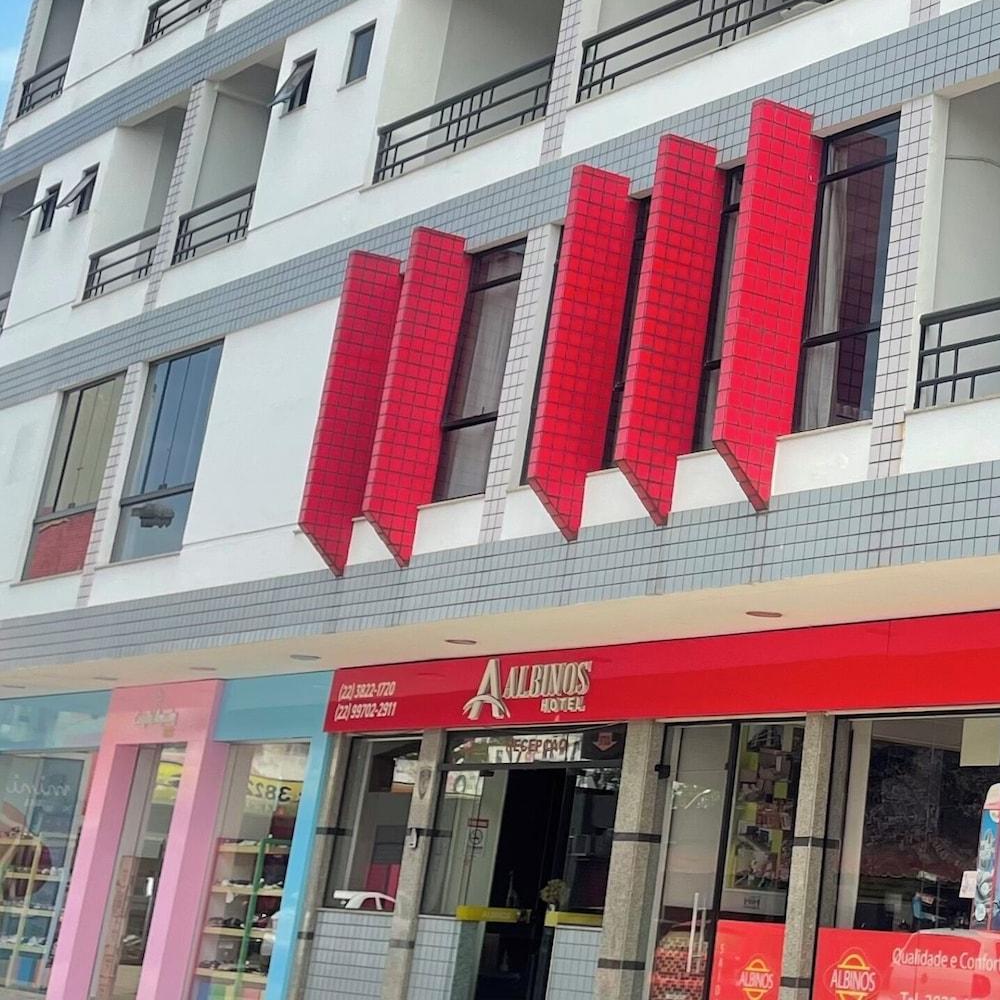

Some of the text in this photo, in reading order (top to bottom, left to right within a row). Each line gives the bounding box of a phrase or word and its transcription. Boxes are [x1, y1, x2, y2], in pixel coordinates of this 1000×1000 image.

[502, 661, 593, 699] ALBINOS
[338, 681, 396, 702] (22) 3822-1720
[334, 702, 397, 722] (22) 99702-2911
[540, 696, 586, 713] HOTEL
[891, 947, 951, 968] Qualidade
[951, 955, 958, 969] e
[739, 970, 774, 989] ALBINOS
[830, 968, 876, 993] ALBINOS
